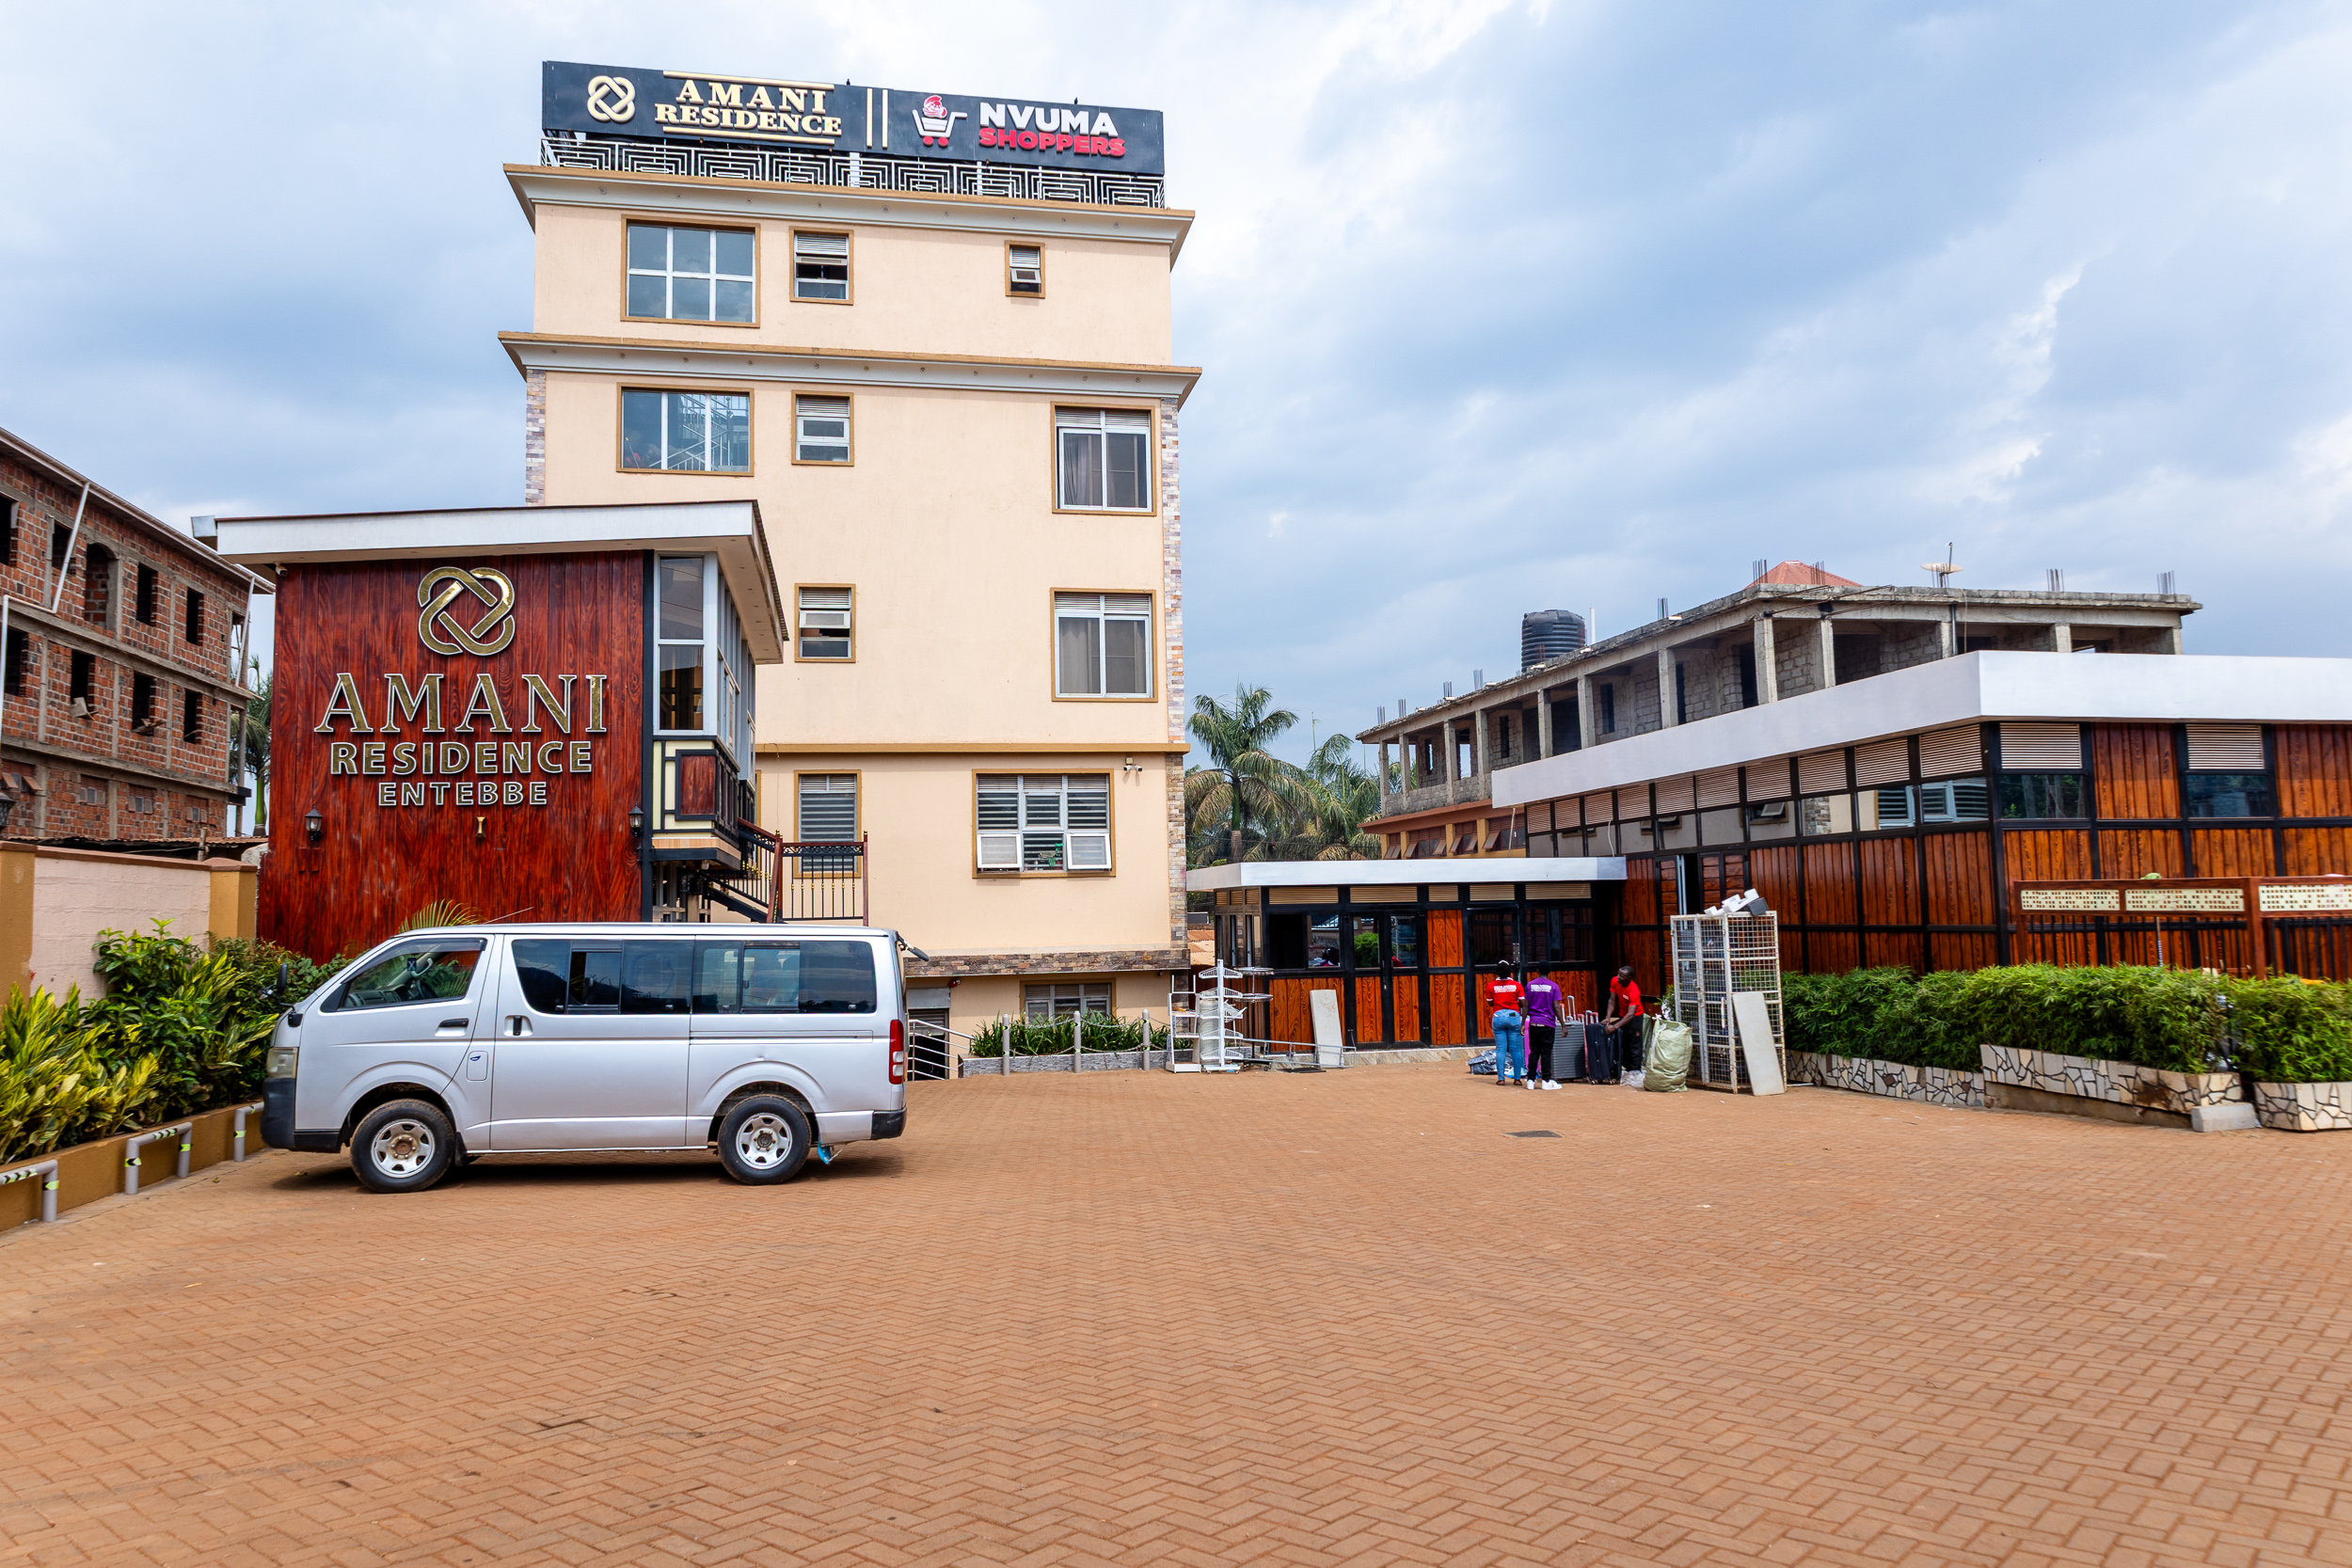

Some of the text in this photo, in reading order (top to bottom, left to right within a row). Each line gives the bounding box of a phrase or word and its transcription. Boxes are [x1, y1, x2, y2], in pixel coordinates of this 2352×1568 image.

[675, 79, 826, 114] AMANI
[655, 103, 842, 136] RESIDENCE
[979, 102, 1119, 137] NVUMA
[978, 127, 1126, 158] SHOPPERS
[313, 673, 608, 734] AMANI
[330, 740, 592, 775] RESIDENCE
[378, 782, 548, 806] ENTEBBE
